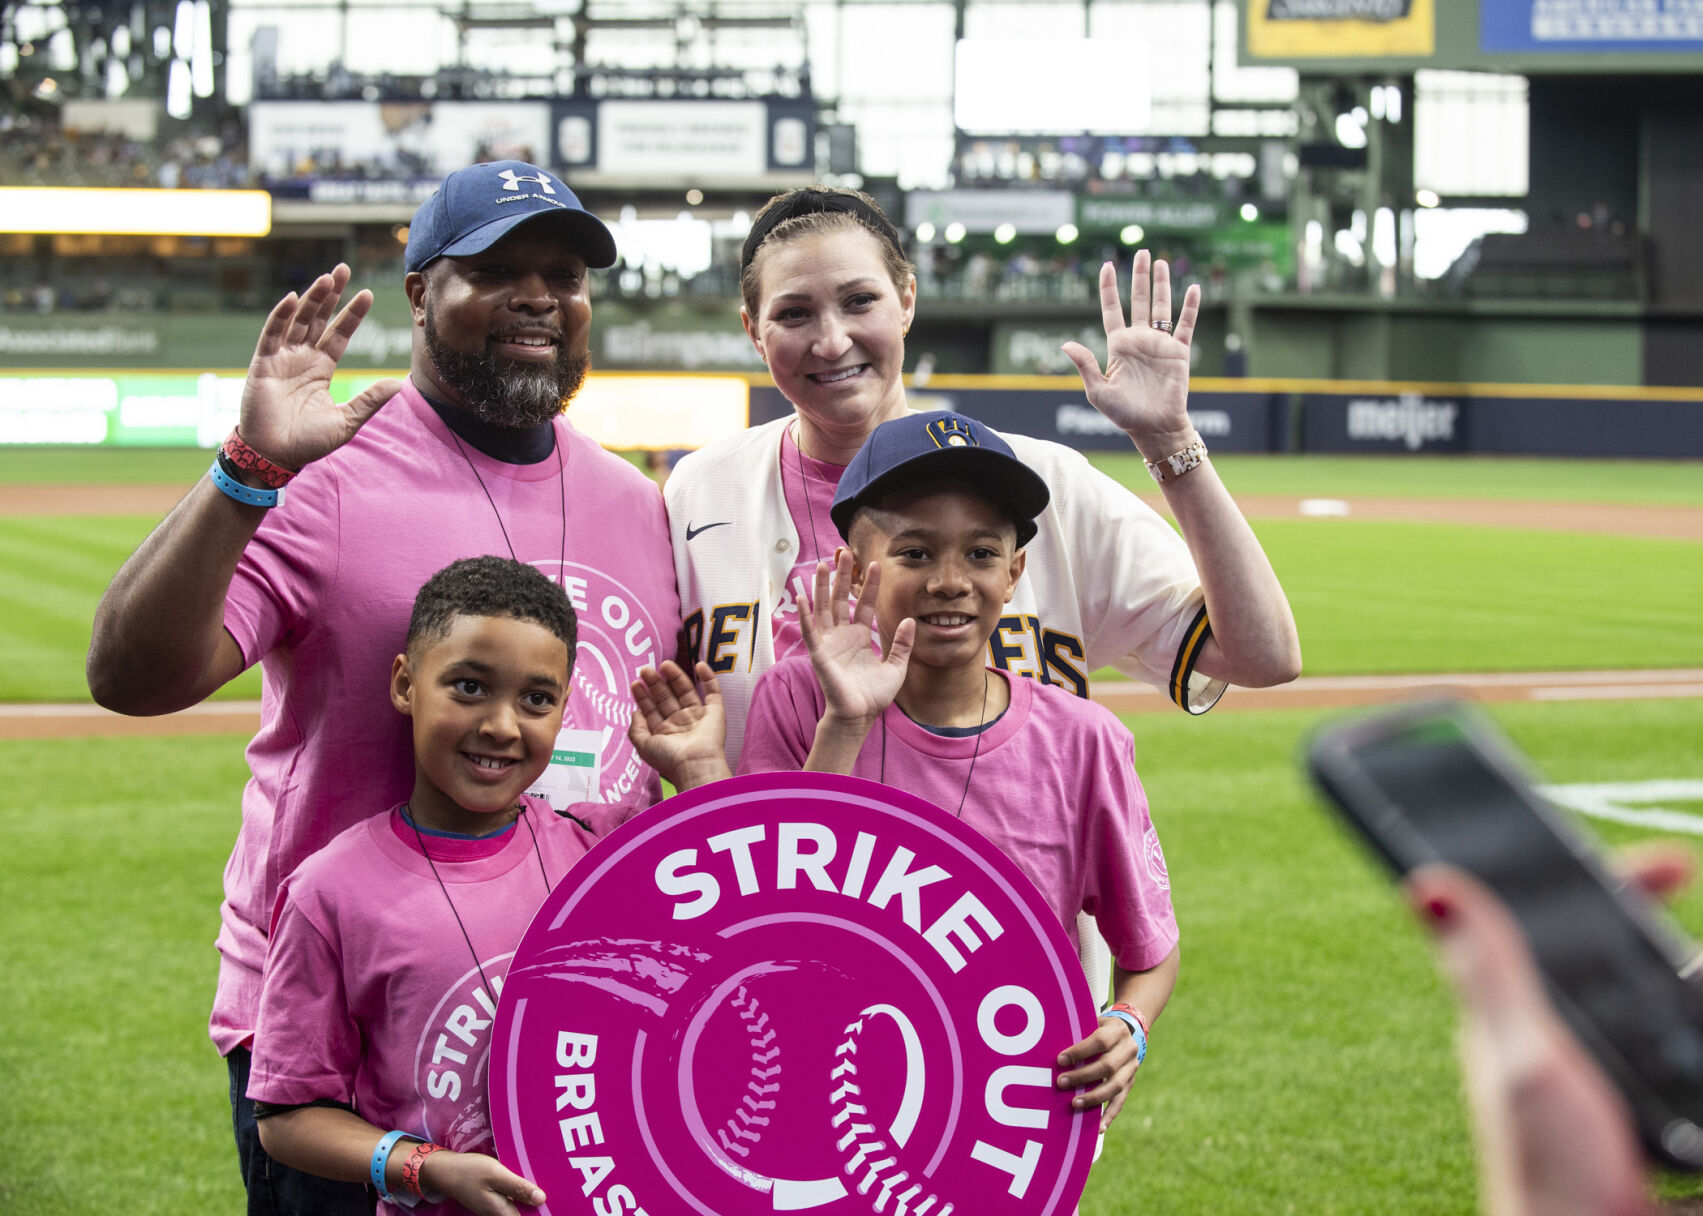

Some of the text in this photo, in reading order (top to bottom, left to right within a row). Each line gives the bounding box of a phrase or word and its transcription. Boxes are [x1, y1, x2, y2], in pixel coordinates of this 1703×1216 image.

[496, 193, 567, 208] UNDER ARMOUR
[654, 822, 1053, 1199] STRIKE OUT
[554, 1030, 651, 1216] BREAS
